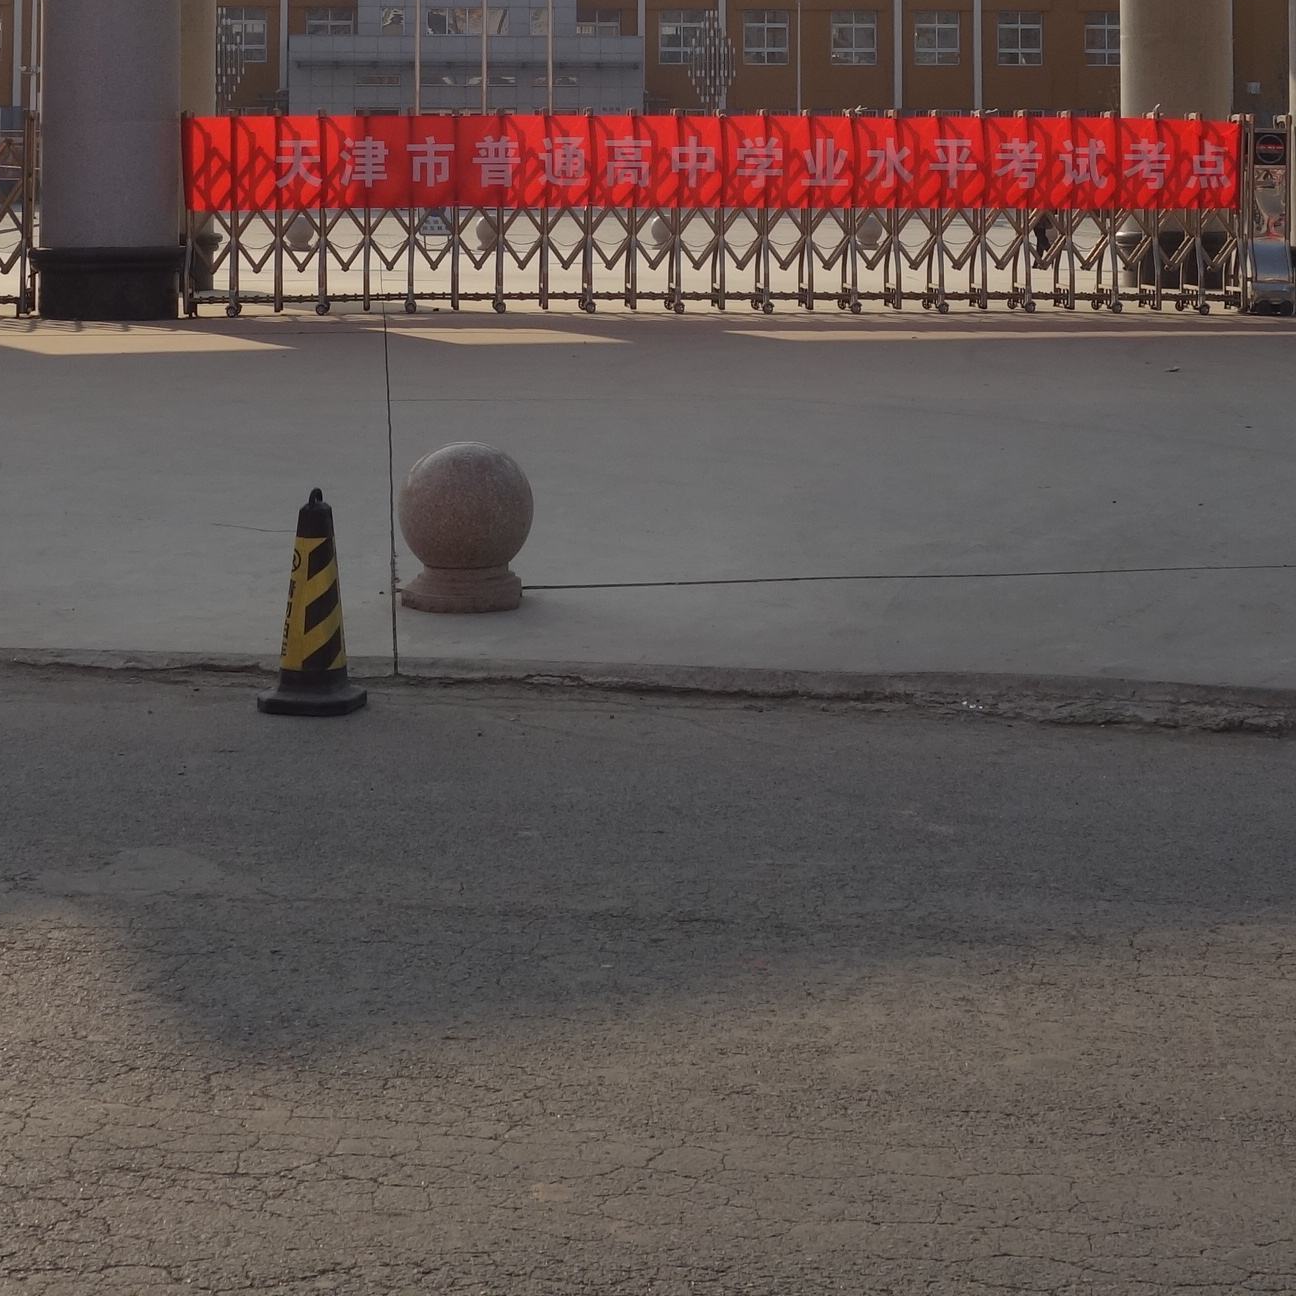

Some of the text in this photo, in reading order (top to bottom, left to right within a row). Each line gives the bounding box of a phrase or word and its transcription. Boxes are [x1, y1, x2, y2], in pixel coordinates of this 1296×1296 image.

[275, 135, 1232, 190] 天津市普通高中学业水平考试考点
